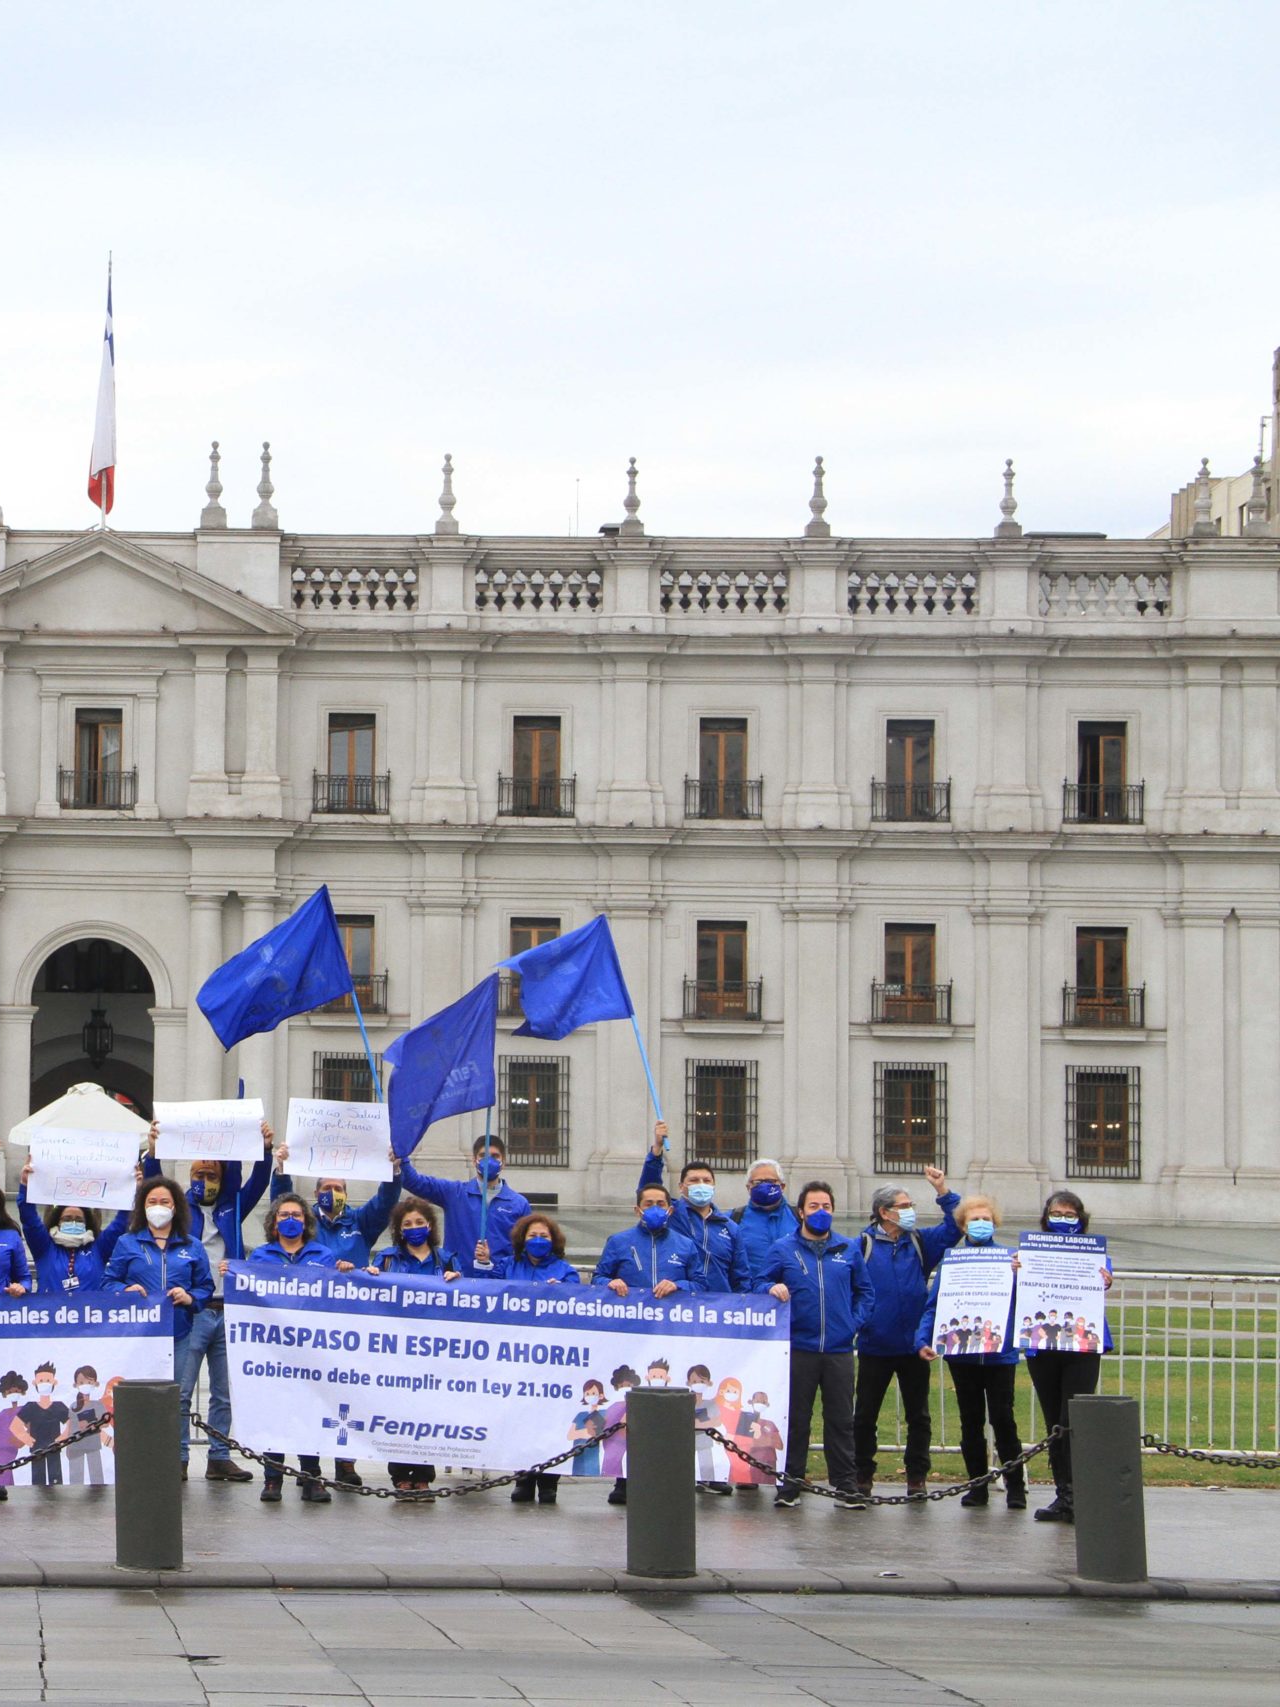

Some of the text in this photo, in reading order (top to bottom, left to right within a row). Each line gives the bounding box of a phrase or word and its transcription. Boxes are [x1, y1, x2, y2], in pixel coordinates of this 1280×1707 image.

[346, 1106, 381, 1119] Salud
[298, 1116, 373, 1131] Metropolitano
[83, 1136, 119, 1149] Salud
[320, 1148, 352, 1167] 197
[63, 1180, 101, 1197] 360
[1028, 1234, 1097, 1245] DIGNIDAD LABORAL
[235, 1273, 777, 1327] Dignidad laboral para las y los profesionales de la salud
[1050, 1293, 1083, 1302] Fenpruss
[55, 1306, 79, 1324] de
[85, 1305, 103, 1324] la
[108, 1304, 161, 1323] salud
[229, 1321, 590, 1368] ¡TRASPASO EN ESPEJO AHORA!
[242, 1360, 573, 1399] Gobierno debe cumplir con Ley 21.106
[369, 1415, 488, 1441] Fenpruss
[371, 1439, 412, 1449] Confederación
[447, 1446, 481, 1454] Profesionales
